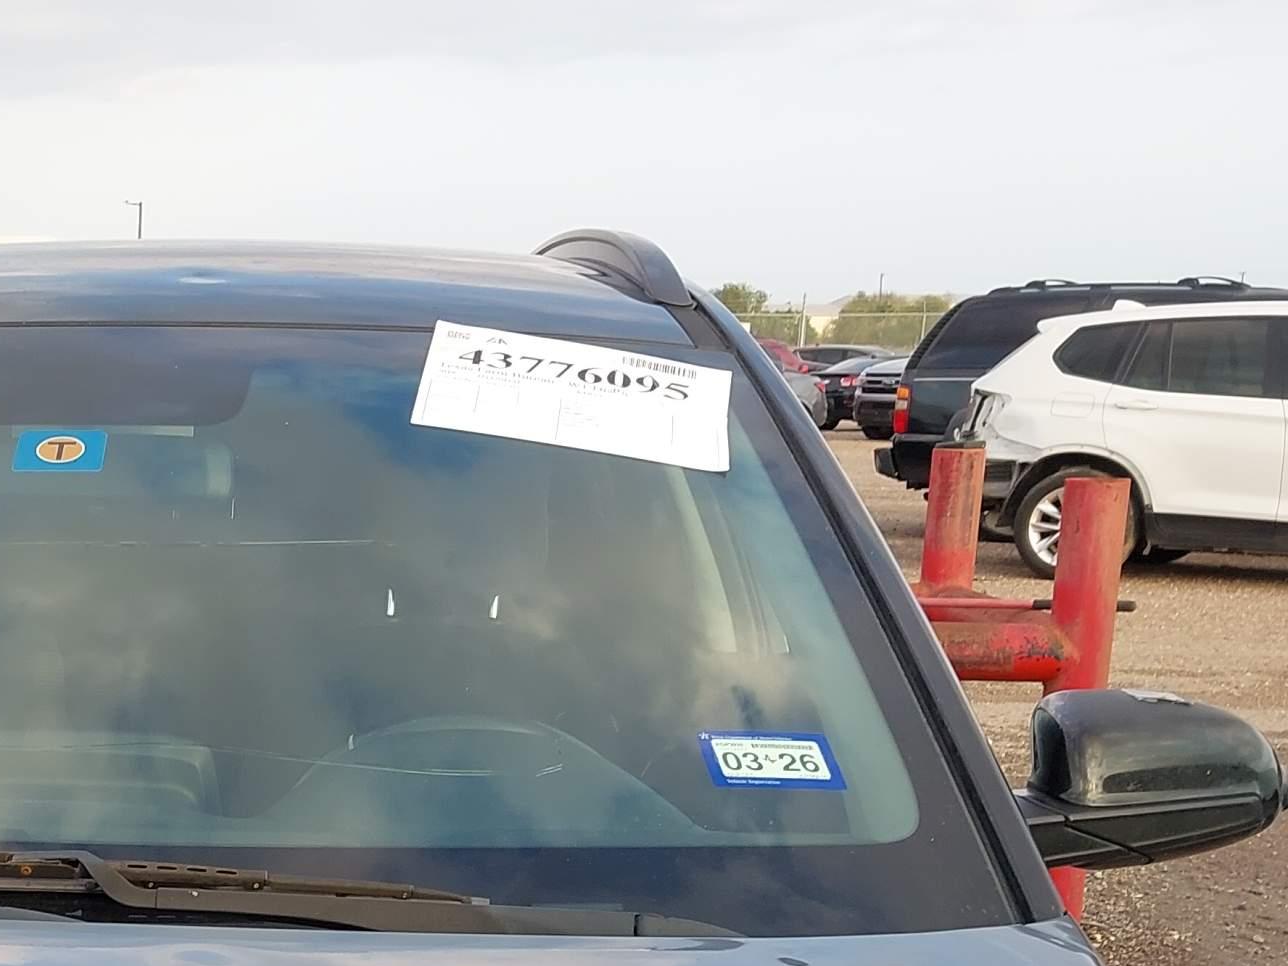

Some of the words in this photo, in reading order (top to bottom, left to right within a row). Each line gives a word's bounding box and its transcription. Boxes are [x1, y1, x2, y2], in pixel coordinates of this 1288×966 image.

[458, 349, 690, 401] 43776095
[47, 440, 78, 461] T
[721, 751, 764, 771] 03
[778, 752, 821, 773] 26
